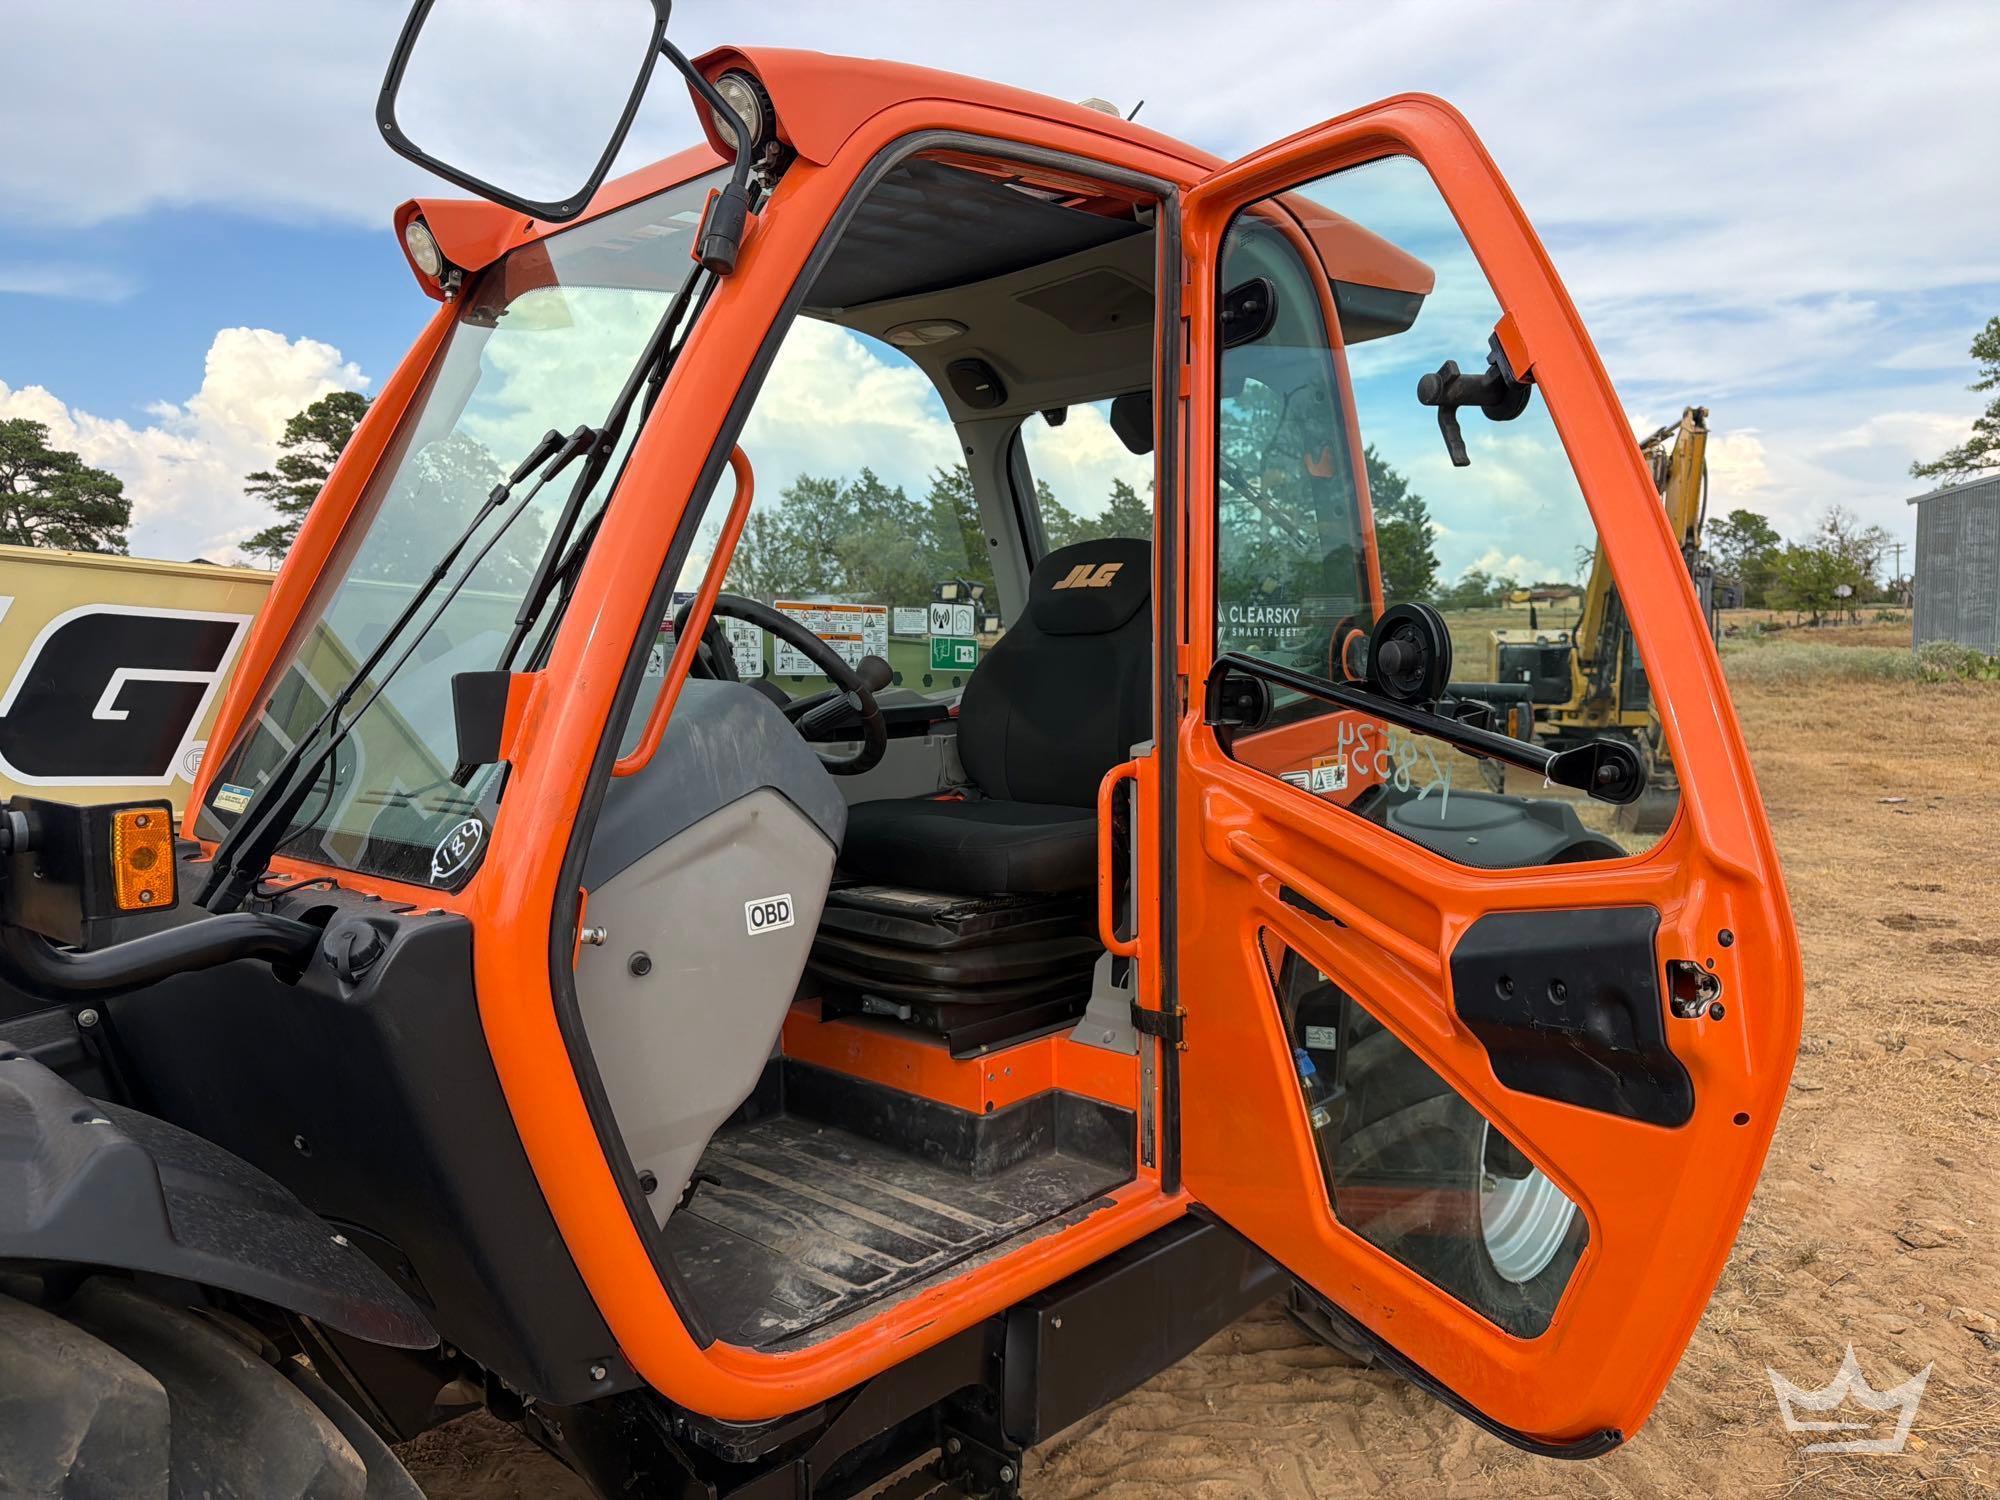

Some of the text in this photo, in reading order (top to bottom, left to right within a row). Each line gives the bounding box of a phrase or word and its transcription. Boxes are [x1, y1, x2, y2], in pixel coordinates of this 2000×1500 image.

[1052, 563, 1124, 590] JLG
[1229, 606, 1300, 624] CLEARSKY
[1232, 627, 1297, 637] SMART FLEET
[751, 901, 790, 927] OBD
